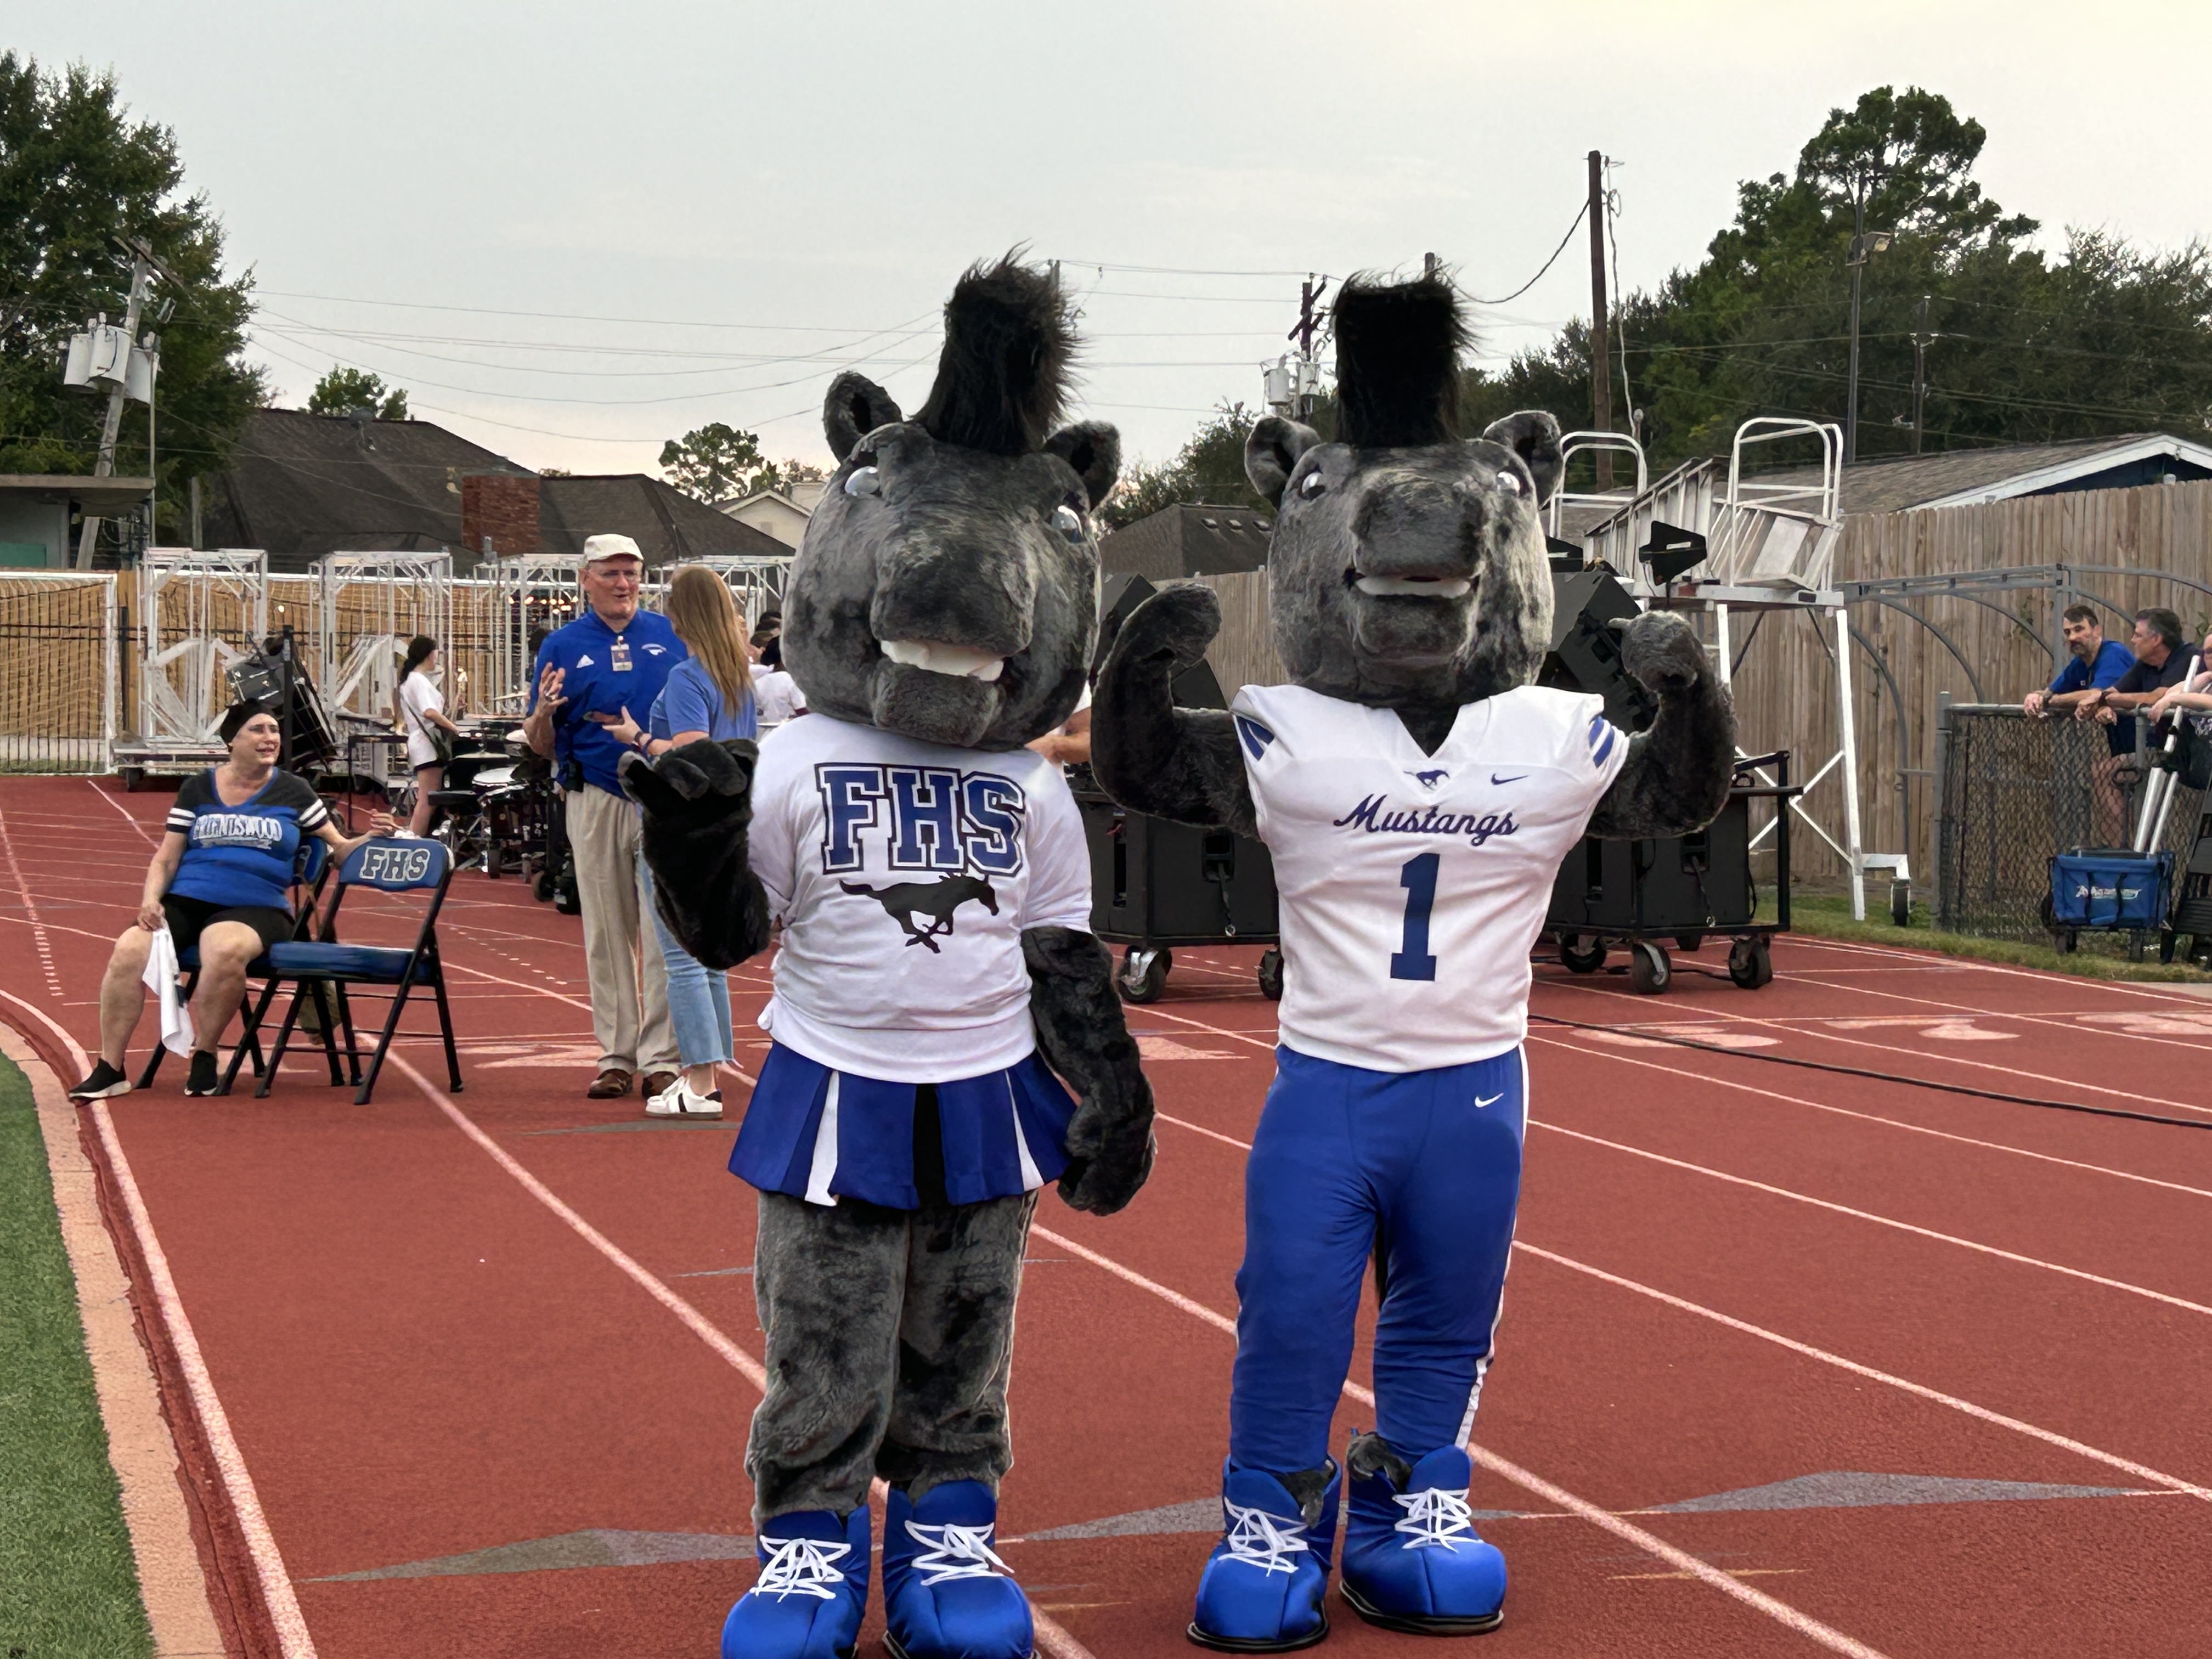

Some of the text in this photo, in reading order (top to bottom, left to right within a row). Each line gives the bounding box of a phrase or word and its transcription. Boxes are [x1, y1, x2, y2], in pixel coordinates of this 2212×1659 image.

[815, 762, 1025, 878] FHS
[1333, 794, 1520, 847] Mustangs
[359, 846, 431, 882] FHS
[1390, 852, 1440, 981] 1
